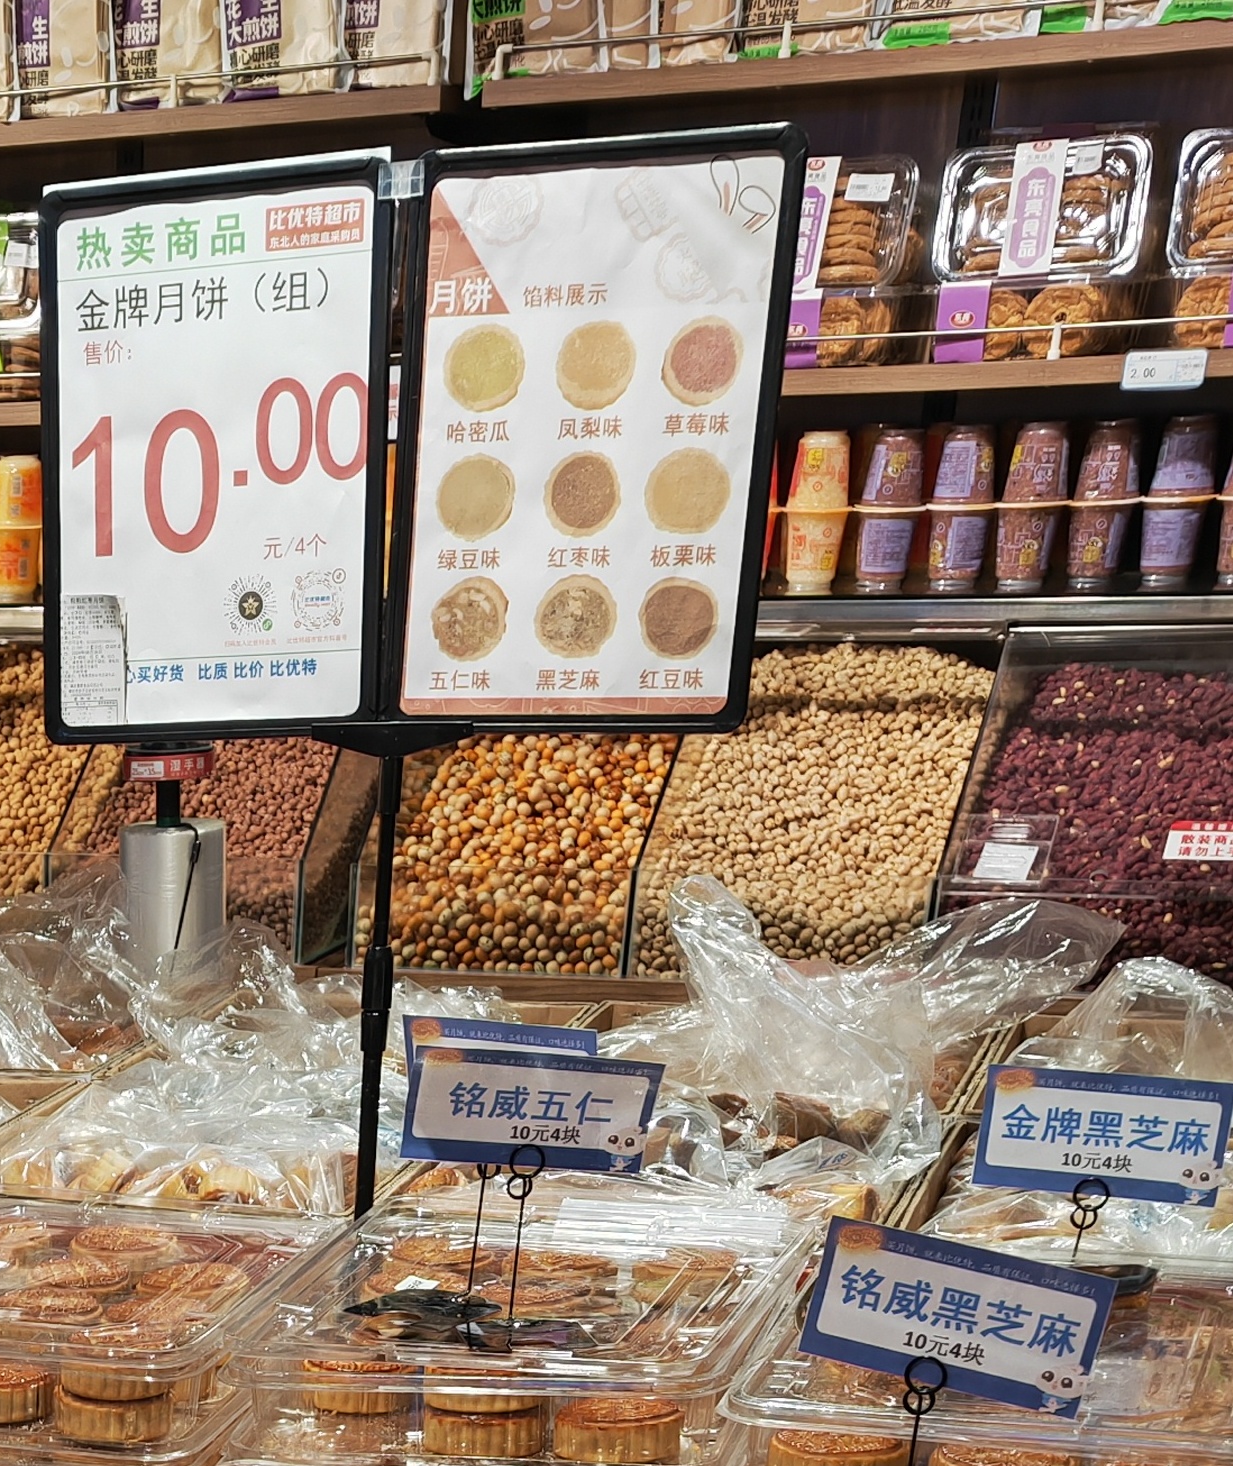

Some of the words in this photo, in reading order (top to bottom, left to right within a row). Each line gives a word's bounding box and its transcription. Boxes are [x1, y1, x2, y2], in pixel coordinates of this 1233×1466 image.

[228, 16, 279, 45] 大煎饼
[269, 201, 360, 231] 比优特超市
[76, 213, 246, 271] 热卖商品
[269, 229, 360, 249] 东北人的家庭采购员
[76, 267, 328, 332] 金牌月饼（组）
[429, 279, 492, 315] 月饼
[523, 283, 608, 308] 馅料展示
[446, 419, 510, 443] 哈密瓜
[557, 416, 623, 440] 凤梨味
[662, 413, 730, 436] 草莓味
[72, 372, 368, 557] 10.00
[263, 534, 327, 559] 元/4个
[547, 546, 611, 568] 红枣味
[650, 544, 716, 567] 板栗味
[437, 549, 500, 570] 绿豆味
[126, 663, 183, 684] 心买好货
[198, 663, 228, 680] 比质
[234, 661, 264, 679] 比价
[270, 658, 317, 677] 比优特
[429, 671, 490, 691] 五仁味
[536, 669, 600, 690] 黑芝麻
[639, 668, 703, 690] 红豆味
[1181, 834, 1233, 844] 散装商
[449, 1081, 613, 1125] 铭威五仁
[509, 1125, 581, 1145] 10元4块
[1001, 1103, 1212, 1157] 金牌黑芝麻
[1061, 1152, 1133, 1174] 10元4块
[841, 1265, 1082, 1358] 铭威黑芝麻
[903, 1331, 985, 1366] 10元4块
